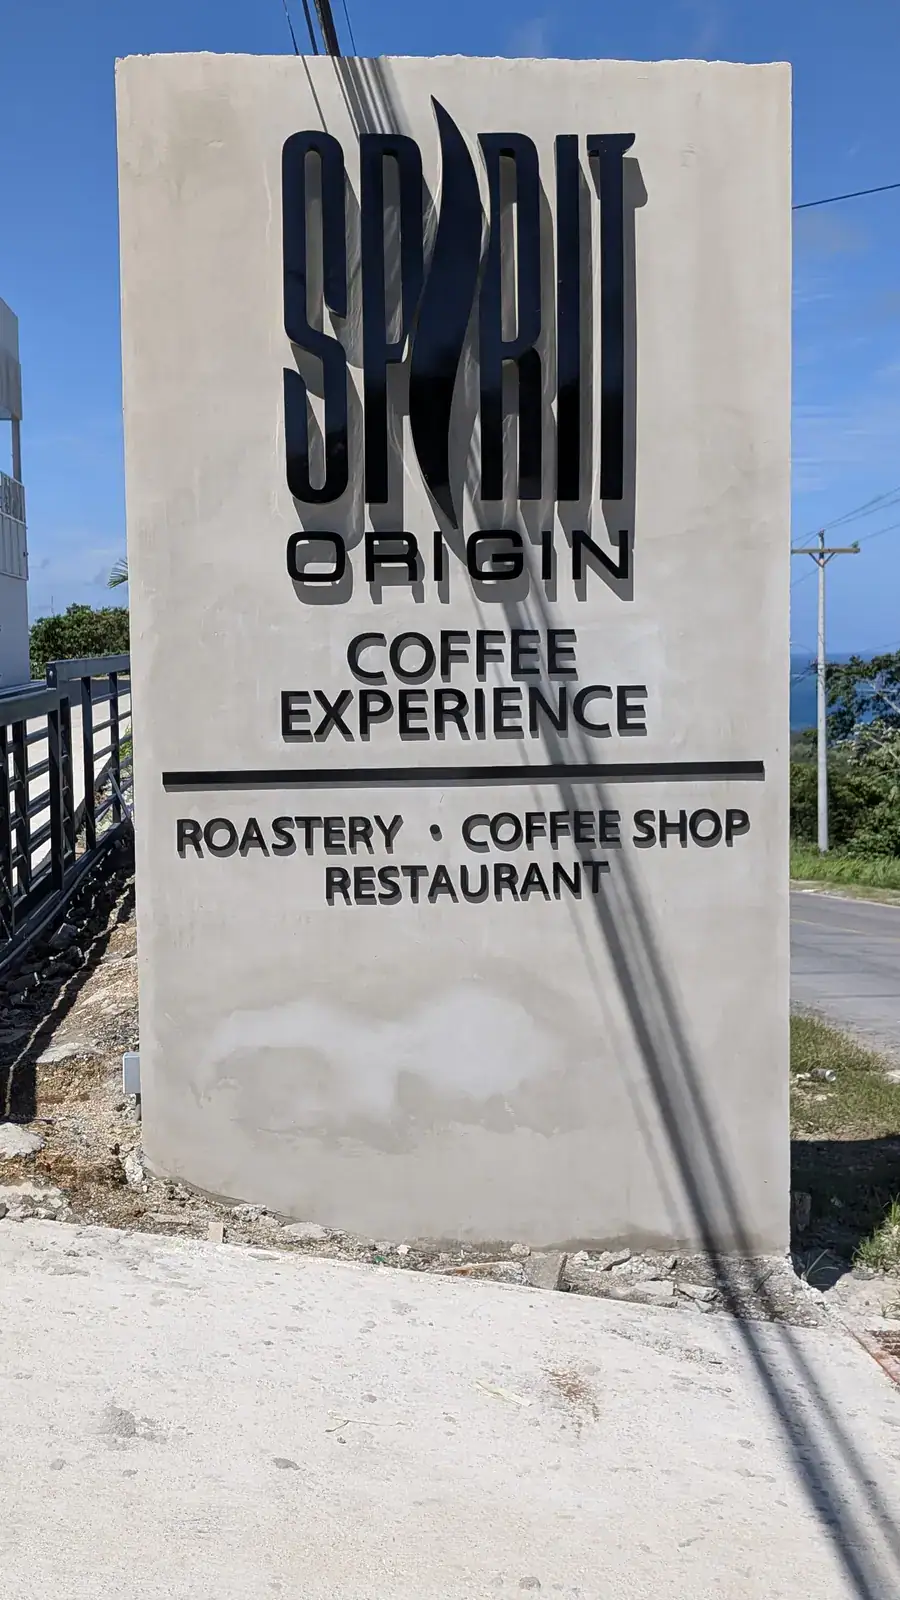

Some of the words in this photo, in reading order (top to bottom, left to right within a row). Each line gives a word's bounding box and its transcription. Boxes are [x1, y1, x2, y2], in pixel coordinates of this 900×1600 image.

[286, 529, 629, 582] ORIGIN
[347, 628, 577, 680] COFFEE
[280, 685, 647, 737] EXPERIENCE
[176, 815, 402, 852] ROASTERY
[461, 810, 620, 847] COFFEE
[632, 808, 749, 842] SHOP
[325, 861, 609, 901] RESTAURANT
